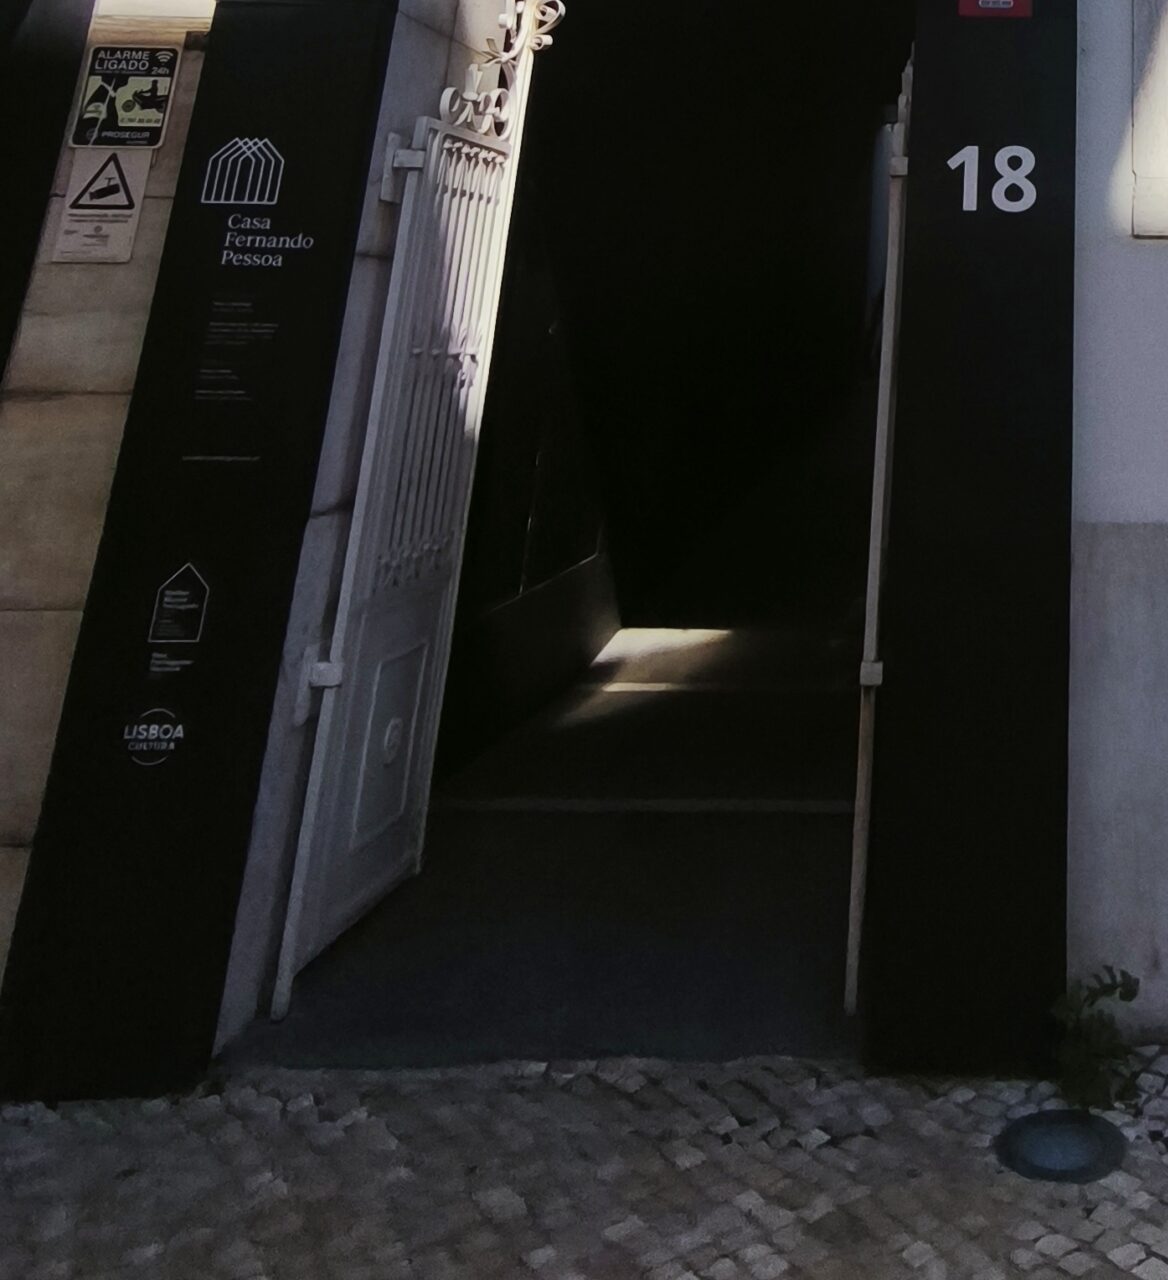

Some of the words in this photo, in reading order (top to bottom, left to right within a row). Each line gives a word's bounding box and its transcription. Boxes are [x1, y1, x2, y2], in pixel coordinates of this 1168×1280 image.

[97, 50, 151, 60] ALARME
[94, 59, 149, 71] LIGADO
[946, 145, 1037, 213] 18
[228, 214, 271, 230] Casa
[224, 231, 314, 249] Fernando
[221, 250, 283, 267] Pessoa
[123, 724, 184, 740] LISBOA
